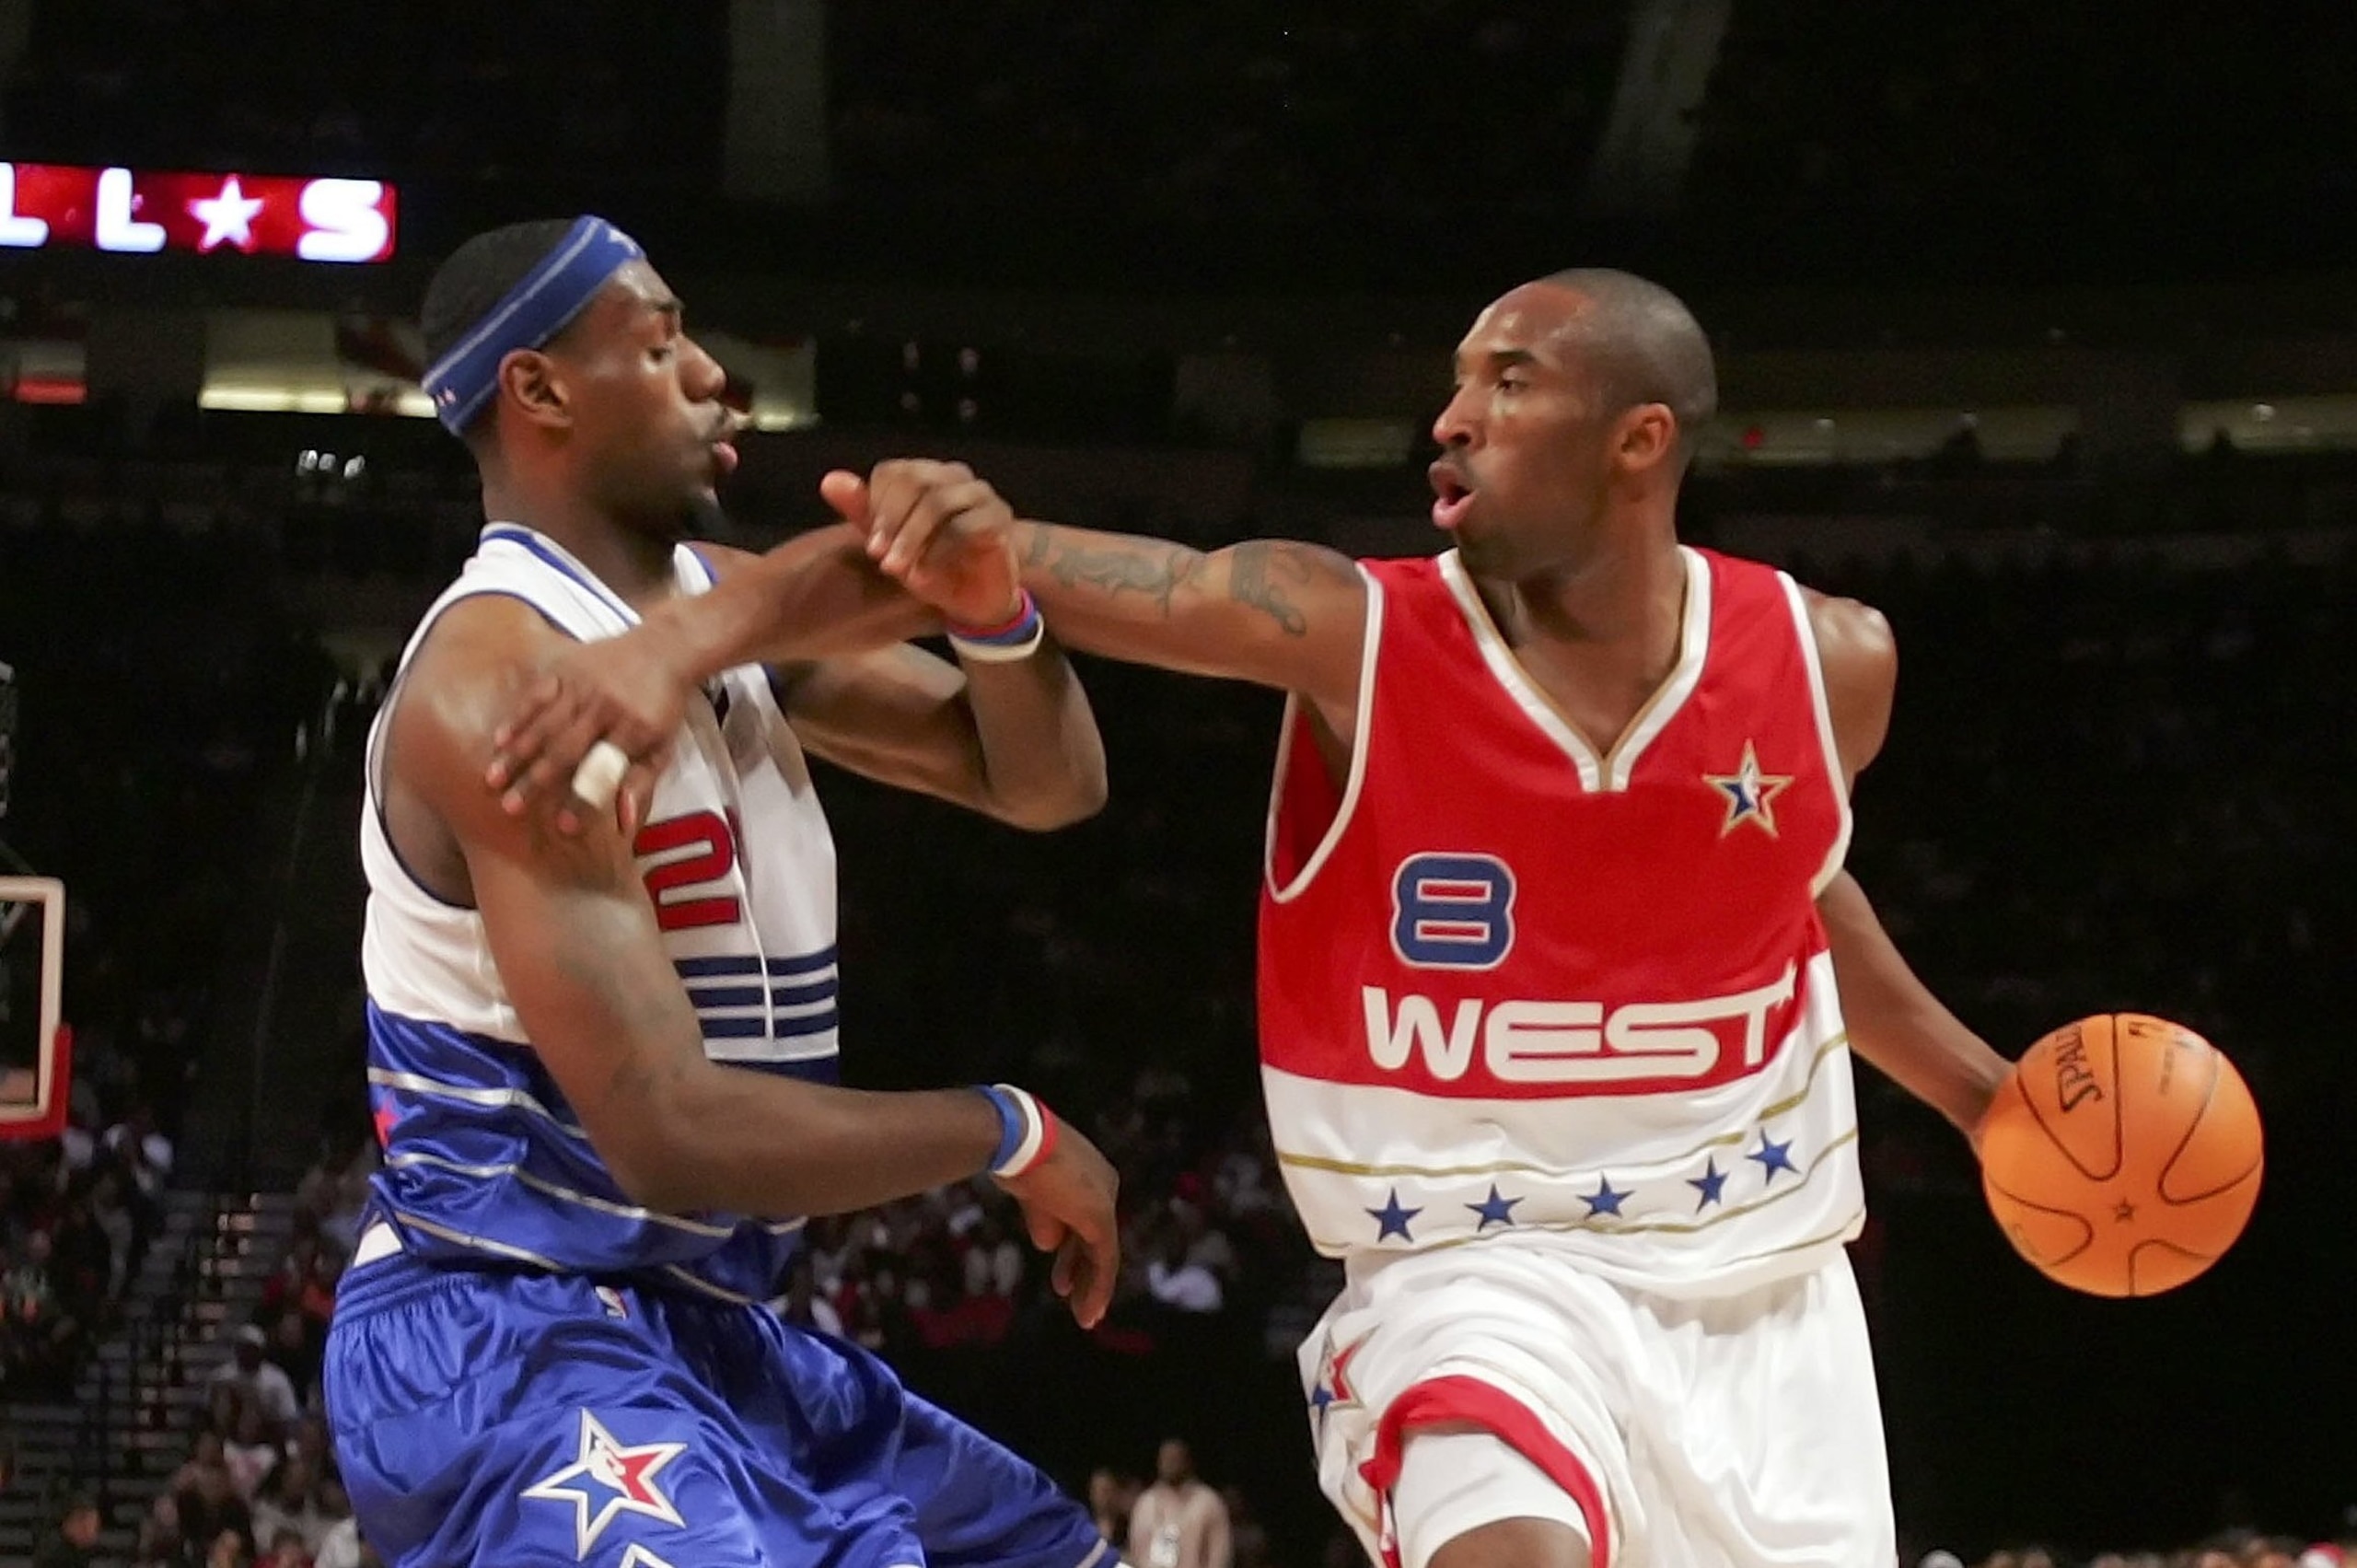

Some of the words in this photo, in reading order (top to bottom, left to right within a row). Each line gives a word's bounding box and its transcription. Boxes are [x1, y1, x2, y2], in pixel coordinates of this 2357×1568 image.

[632, 807, 753, 933] 2
[1389, 851, 1517, 971] 8
[1361, 963, 1795, 1083] WEST
